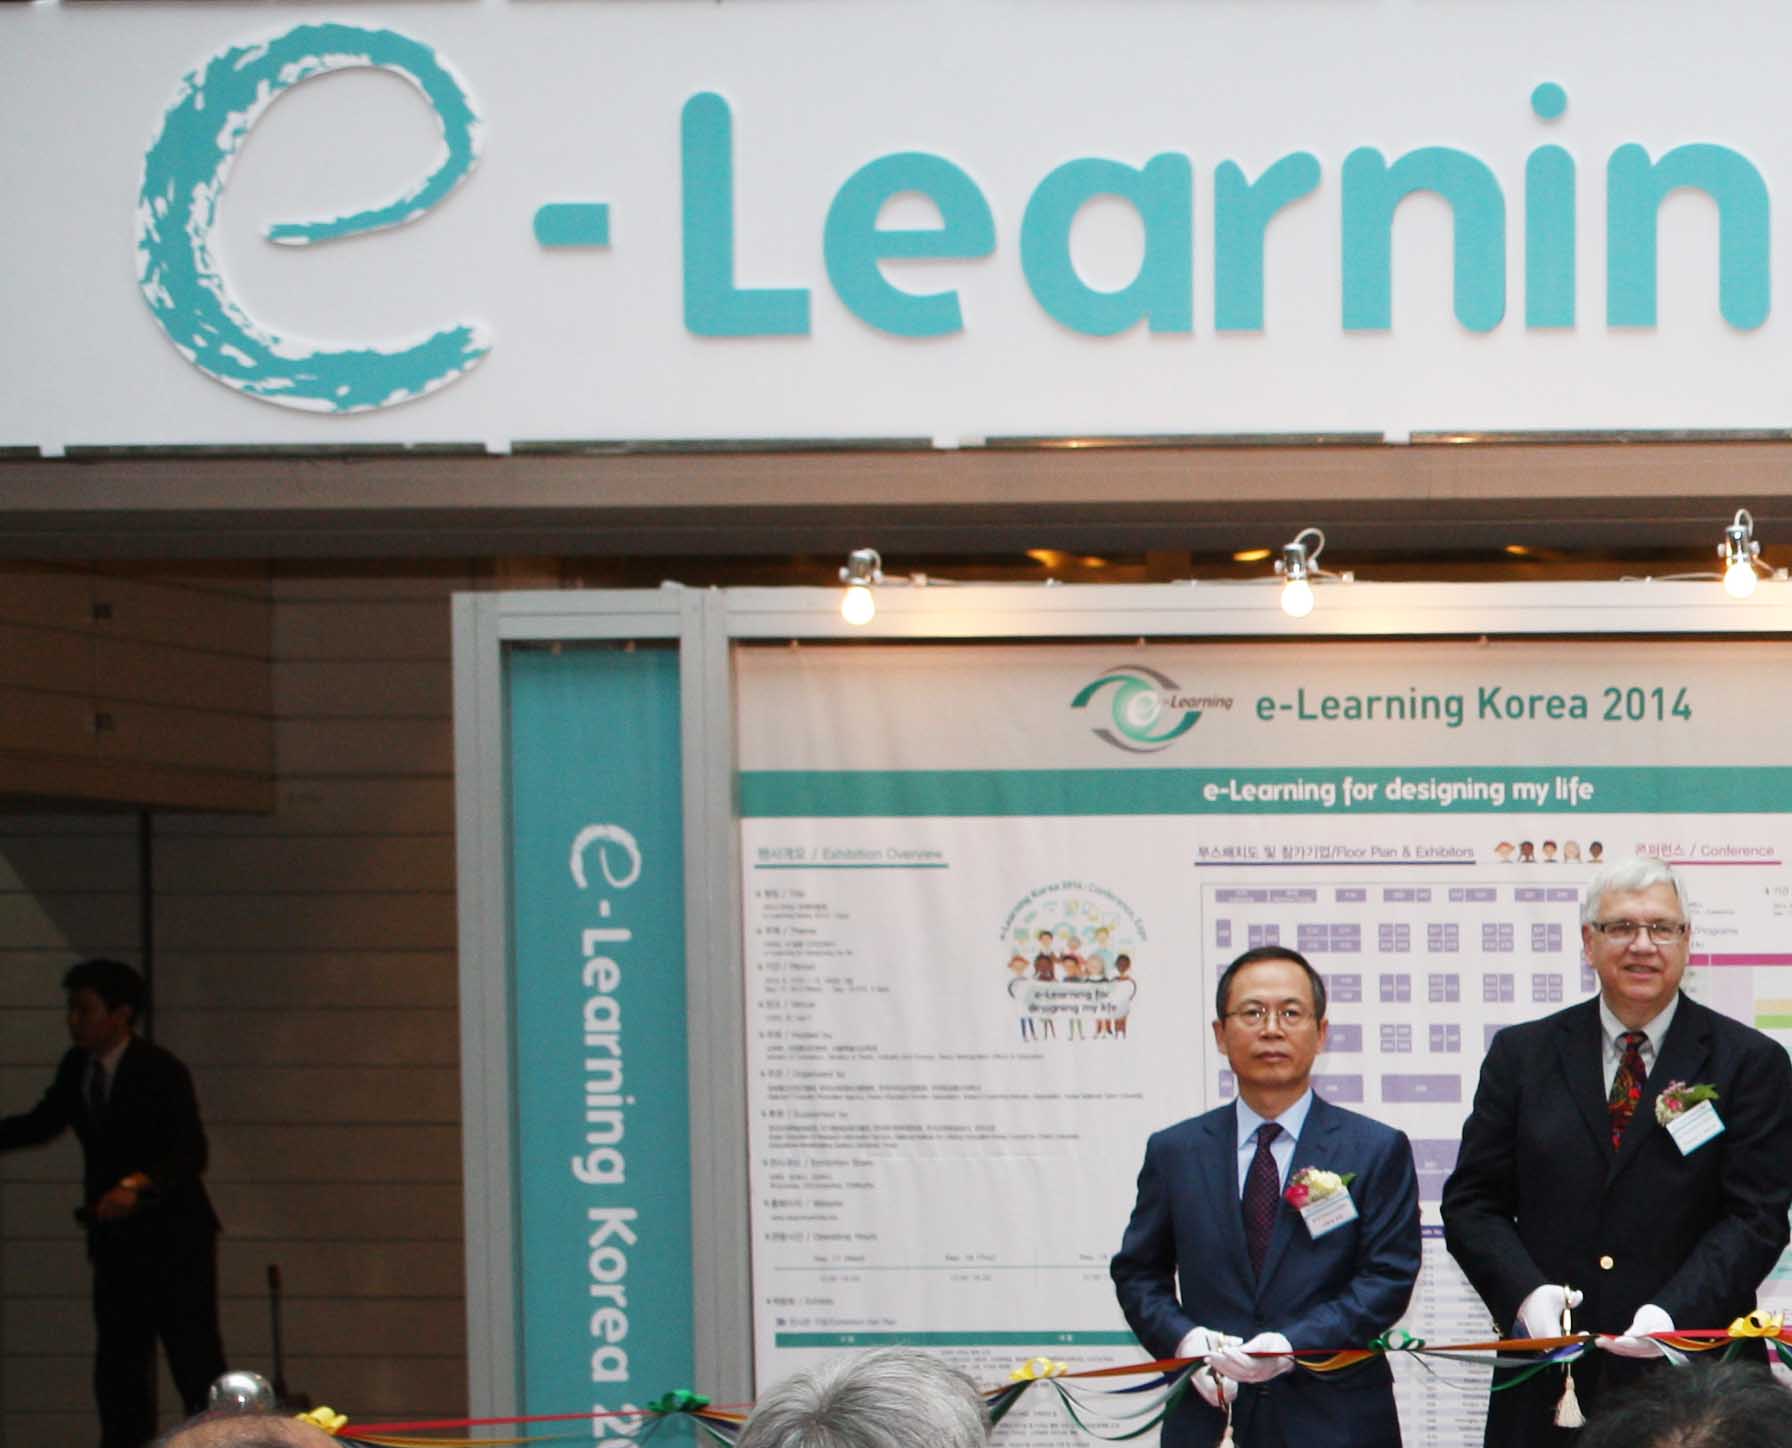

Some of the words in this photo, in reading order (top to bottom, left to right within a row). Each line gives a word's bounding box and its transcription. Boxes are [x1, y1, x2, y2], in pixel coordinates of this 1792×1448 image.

[1256, 687, 1466, 730] e-Learning
[1479, 687, 1589, 721] Korea
[1604, 687, 1693, 722] 2014
[1203, 779, 1336, 808] e-Learning
[1343, 777, 1379, 808] for
[1386, 777, 1506, 808] designing
[1512, 783, 1551, 808] my
[1556, 776, 1595, 808] life
[1700, 843, 1776, 857] Conference
[569, 823, 644, 1186] e-Learning
[587, 1207, 640, 1384] Korea
